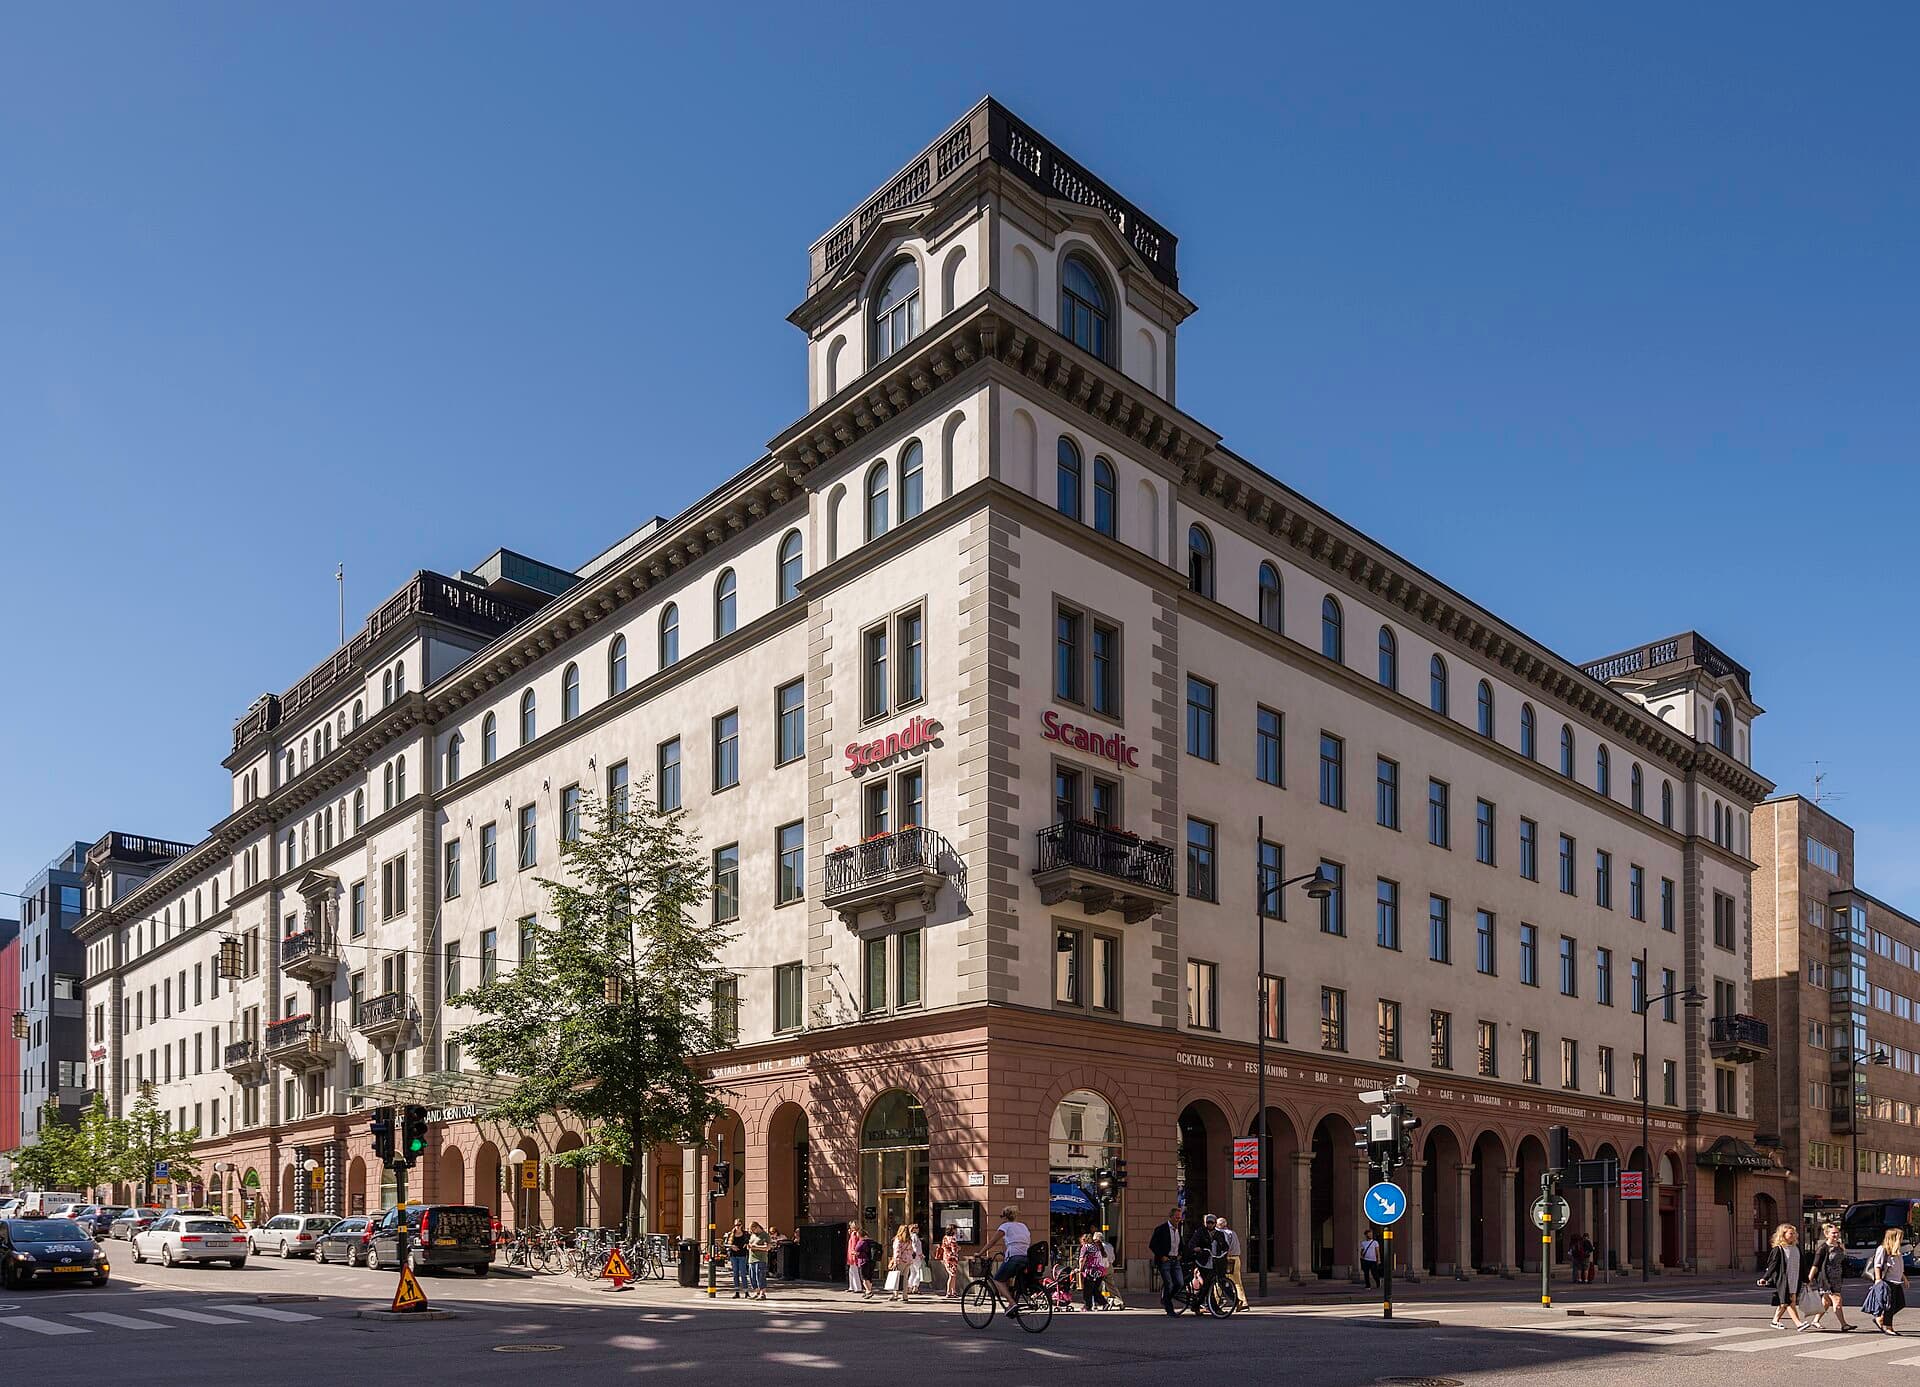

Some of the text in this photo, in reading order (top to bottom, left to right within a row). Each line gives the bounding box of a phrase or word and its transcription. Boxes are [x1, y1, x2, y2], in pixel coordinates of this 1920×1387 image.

[845, 715, 935, 771] Scandic
[1042, 710, 1139, 768] Scandic
[757, 1059, 773, 1072] LIVE
[790, 1055, 806, 1067] BAR
[1176, 1052, 1215, 1068] OCKTAILS
[1315, 1071, 1329, 1083] BAR
[1353, 1077, 1384, 1090] ACOUSTIC
[1473, 1094, 1501, 1106] VASAGATAN
[444, 1104, 476, 1120] CENTRAL
